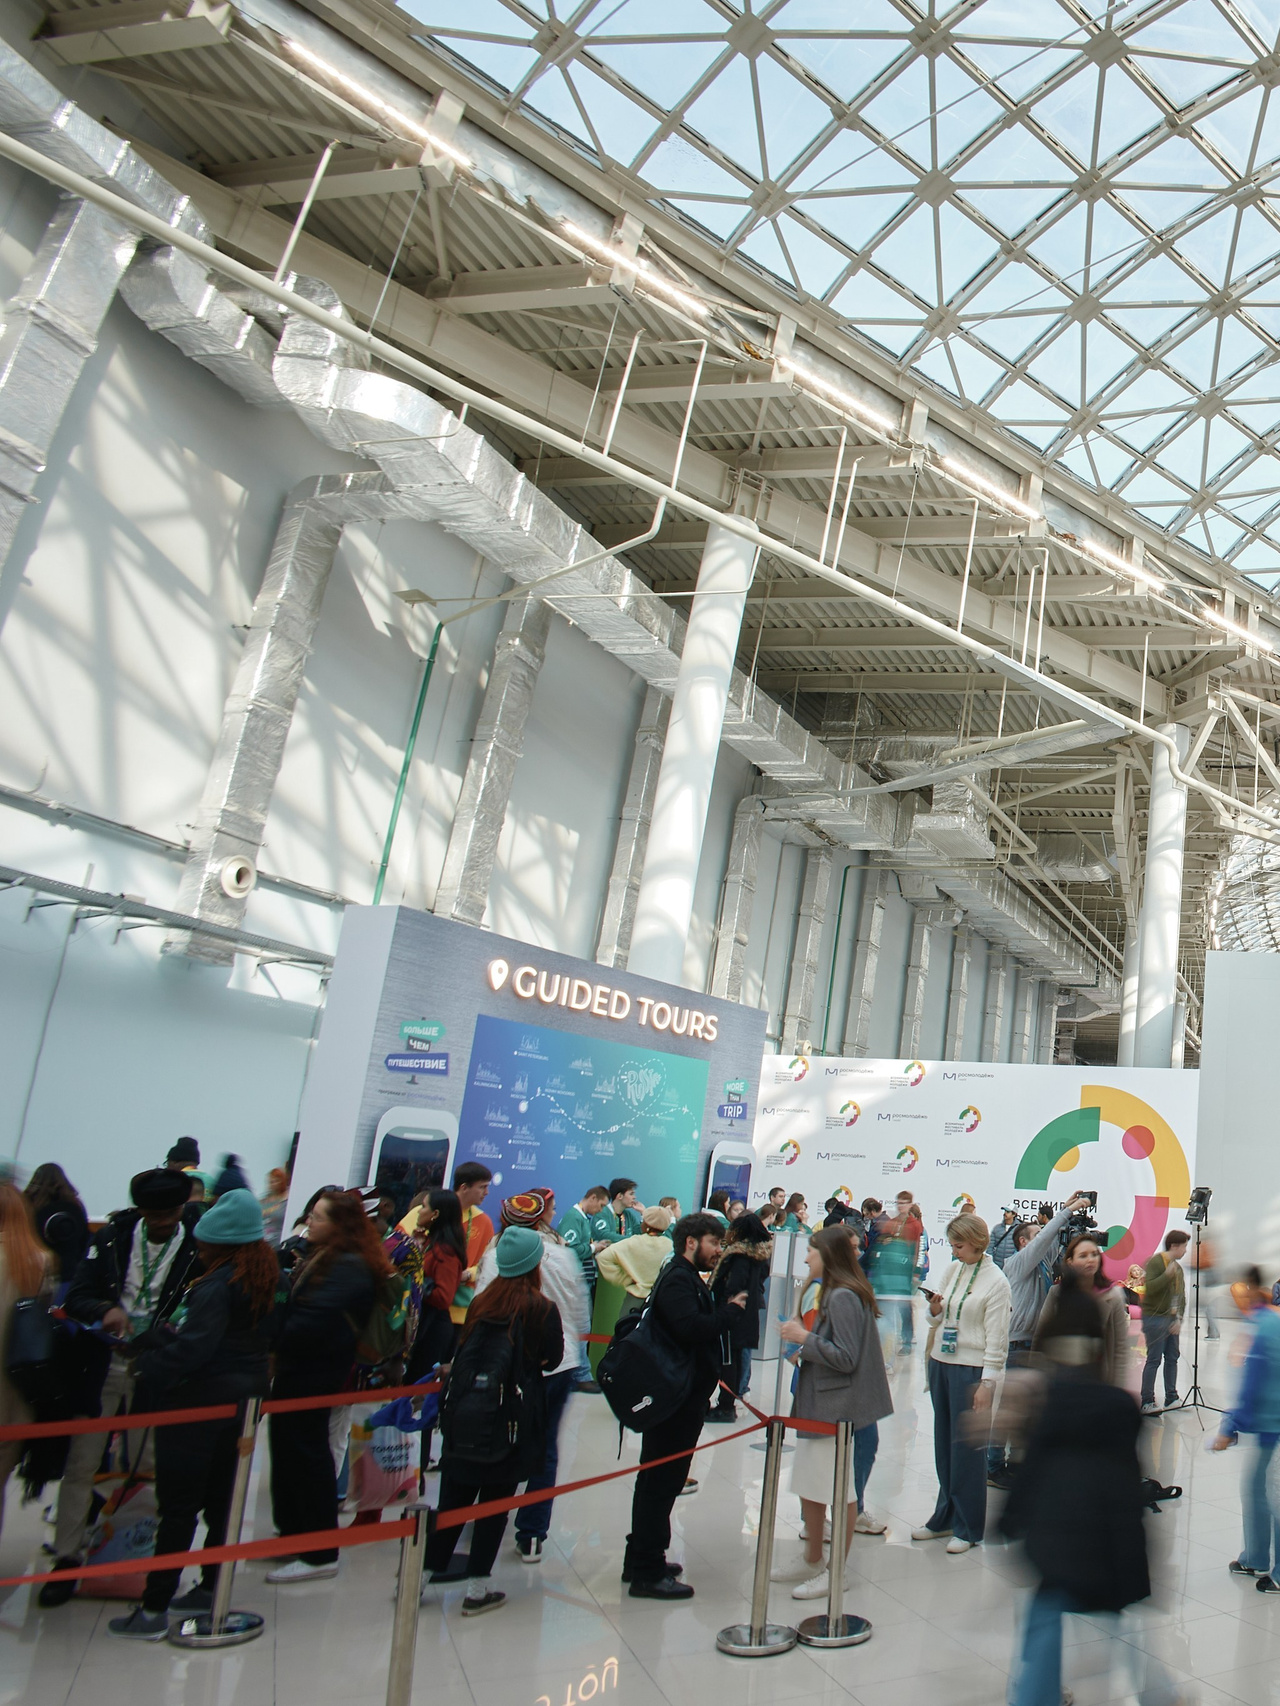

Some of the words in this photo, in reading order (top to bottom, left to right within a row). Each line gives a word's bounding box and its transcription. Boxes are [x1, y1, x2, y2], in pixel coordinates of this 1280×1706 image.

[512, 966, 631, 1020] GUIDED
[637, 996, 719, 1042] TOURS
[403, 1026, 439, 1036] БОЛЬШЕ
[409, 1039, 430, 1051] ЧЕМ
[387, 1058, 447, 1070] ПУТЕШЕСТВИЕ
[726, 1082, 745, 1092] MORE
[723, 1105, 743, 1118] TRIP
